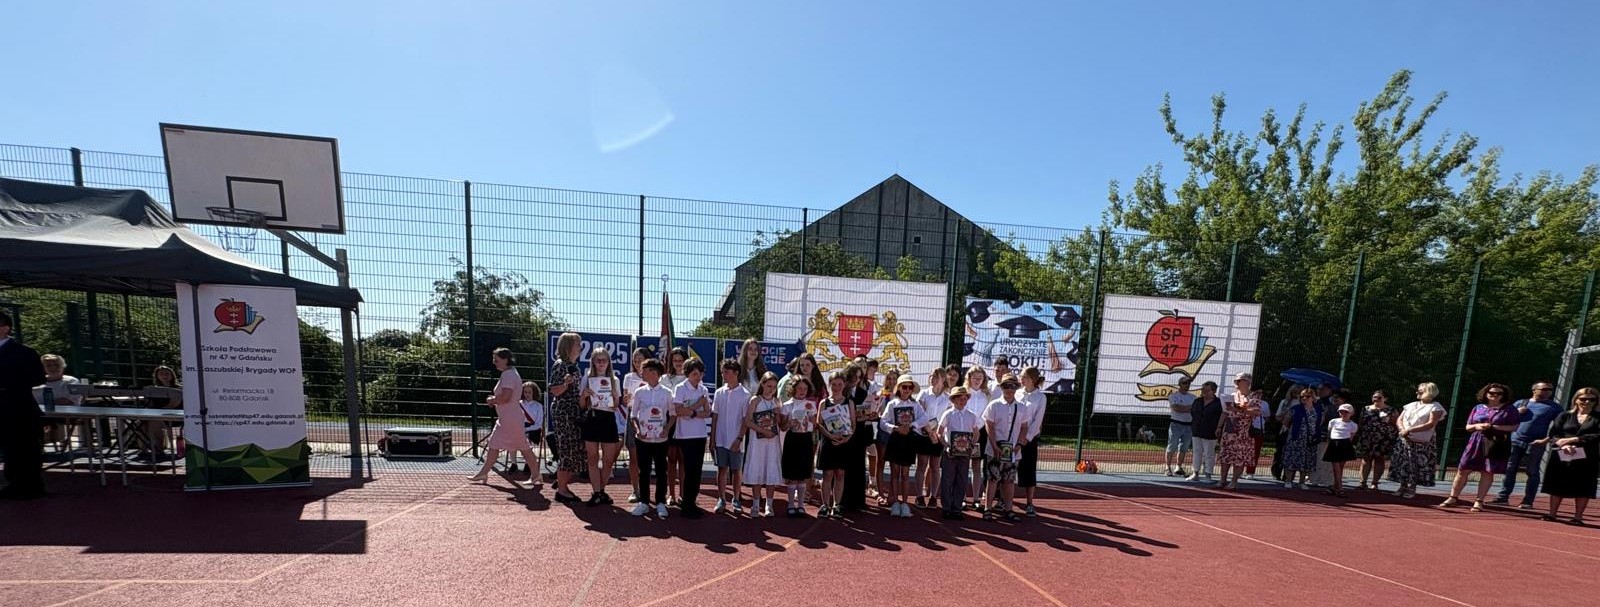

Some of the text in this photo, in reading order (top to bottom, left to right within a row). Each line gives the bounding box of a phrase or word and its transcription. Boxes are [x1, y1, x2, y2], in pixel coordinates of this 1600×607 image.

[1161, 327, 1182, 342] SP
[1000, 338, 1047, 349] UROCZYSTE
[229, 346, 277, 354] Podstawowa
[1161, 344, 1179, 357] 47
[238, 354, 273, 362] Gdańsku
[202, 365, 244, 374] aszubskiej
[245, 366, 278, 375] Brygady
